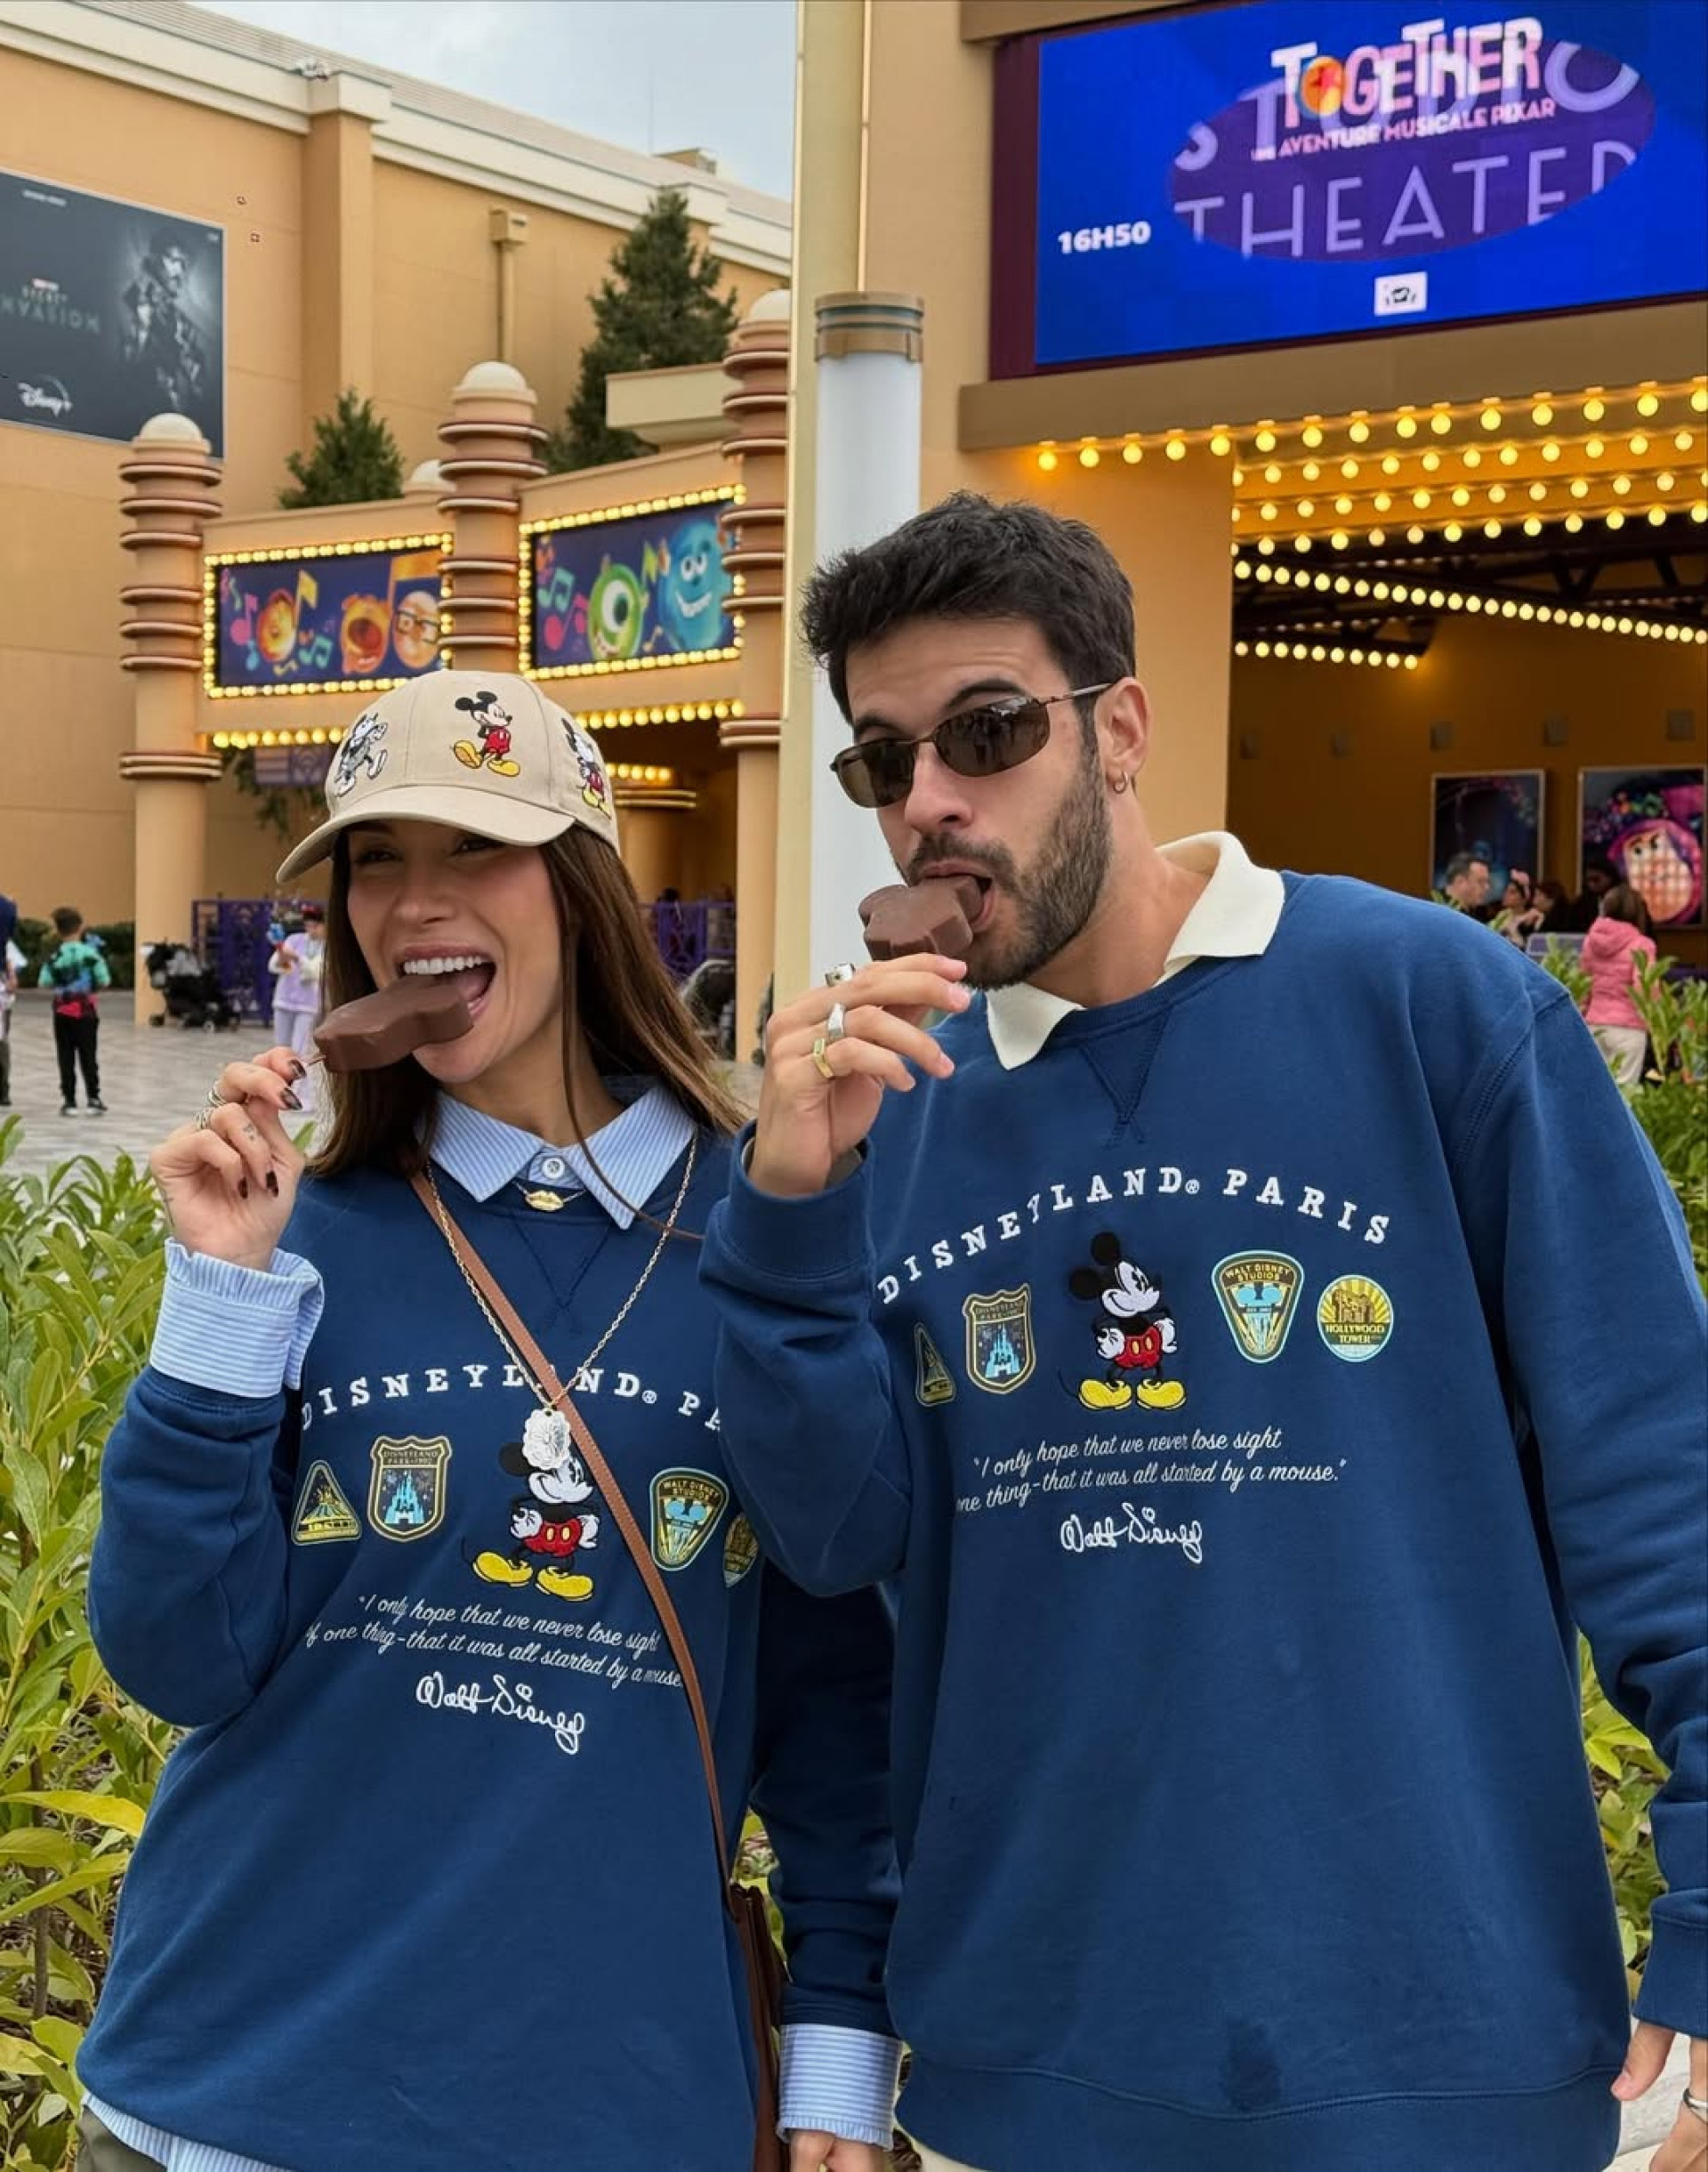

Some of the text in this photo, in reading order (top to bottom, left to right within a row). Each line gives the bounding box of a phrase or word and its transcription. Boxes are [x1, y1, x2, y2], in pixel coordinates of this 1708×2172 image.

[1271, 17, 1543, 128] TOGETHER
[1278, 124, 1381, 157] AVENTURE
[1384, 108, 1487, 141] MUSICALE
[1491, 96, 1556, 126] PIXAR
[1058, 221, 1151, 254] 16H50
[1222, 1168, 1390, 1244] PARIS
[301, 1363, 657, 1431] DISNEYLND®
[994, 1449, 1032, 1478] only
[1037, 1440, 1080, 1466] hope
[1084, 1433, 1117, 1457] that
[1121, 1437, 1145, 1454] we
[1148, 1433, 1188, 1452] never
[1191, 1428, 1228, 1450] lose
[1233, 1425, 1282, 1460] sight
[1080, 1467, 1094, 1488] it
[1096, 1469, 1130, 1487] was
[1132, 1461, 1158, 1484] all
[1161, 1459, 1219, 1483] started
[1221, 1458, 1245, 1493] by
[1250, 1465, 1265, 1482] a
[1060, 1502, 1203, 1564] Walt Disney
[408, 1598, 456, 1627] hope
[460, 1603, 503, 1626] that
[503, 1614, 531, 1630] we
[532, 1618, 584, 1640] never
[586, 1620, 623, 1646] lose
[324, 1626, 358, 1642] one
[447, 1634, 466, 1651] it
[466, 1639, 505, 1659] was
[508, 1641, 542, 1663] all
[540, 1647, 608, 1675] started
[606, 1656, 630, 1691] by
[631, 1667, 644, 1683] a
[415, 1670, 586, 1756] Walt Disney
